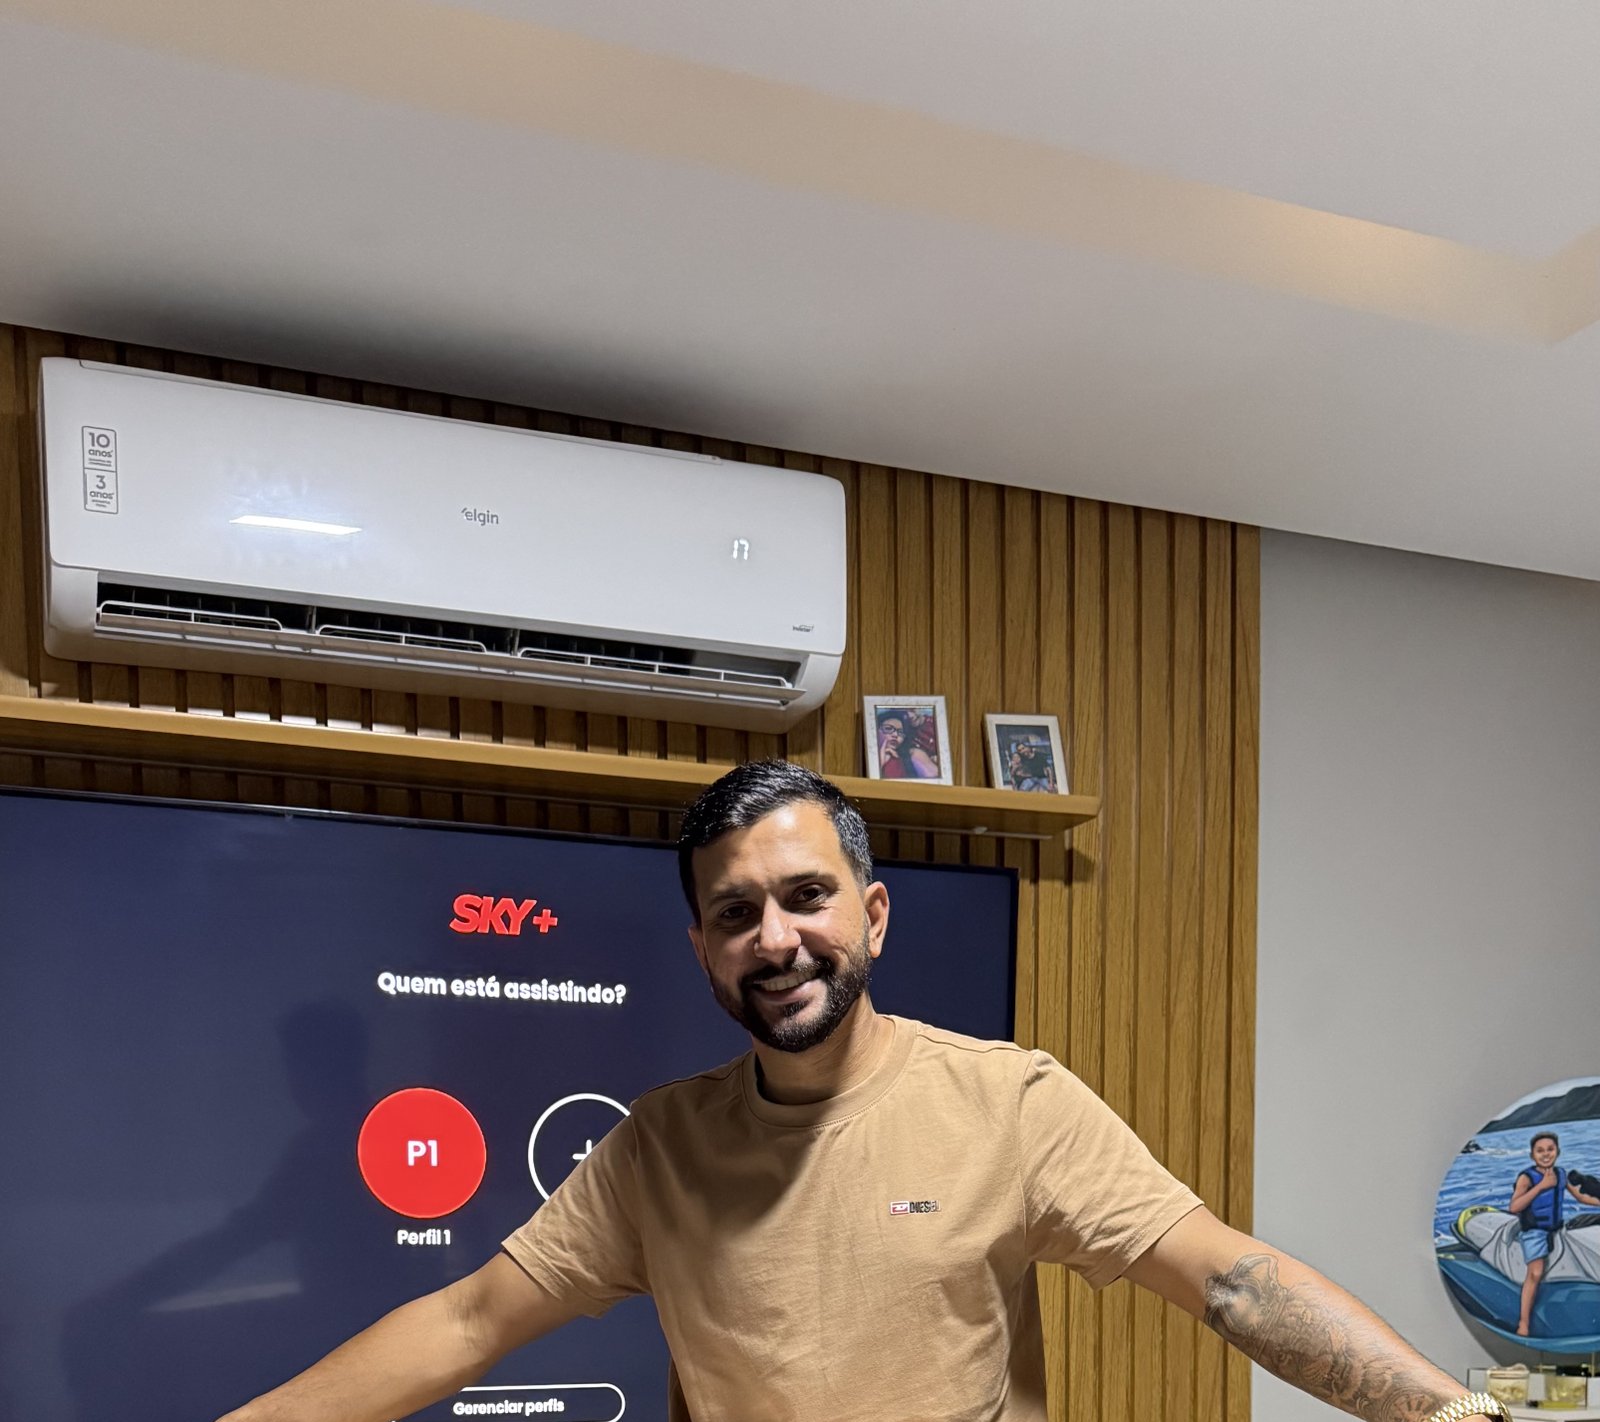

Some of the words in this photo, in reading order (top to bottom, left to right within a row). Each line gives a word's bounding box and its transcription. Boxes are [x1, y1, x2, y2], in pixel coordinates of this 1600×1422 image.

[88, 432, 111, 448] 10
[95, 474, 106, 490] 3
[461, 507, 499, 526] elgin
[377, 971, 447, 995] Quem
[450, 975, 500, 998] está
[503, 978, 627, 1005] assistindo?
[407, 1140, 438, 1167] P1
[397, 1228, 441, 1245] Perfil
[443, 1229, 451, 1245] 1
[453, 1400, 523, 1415] Gerenciar
[525, 1398, 565, 1417] perfis
